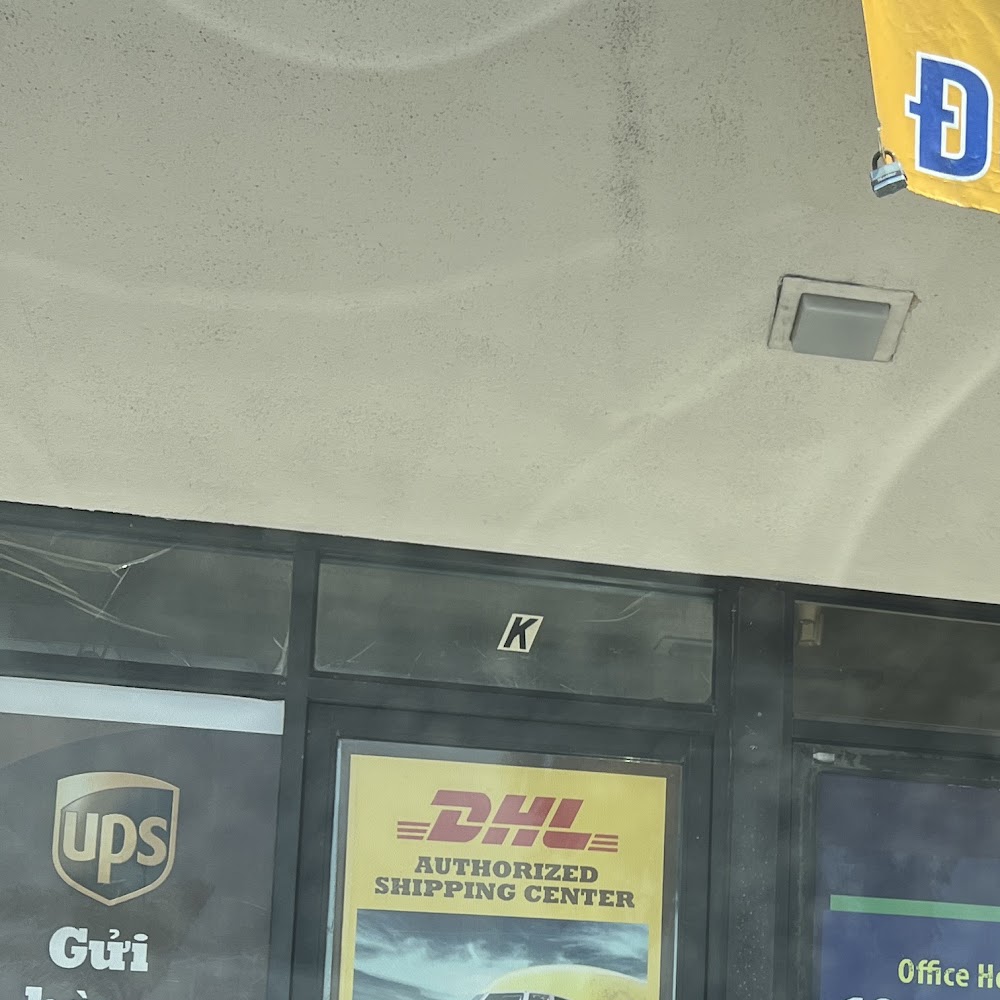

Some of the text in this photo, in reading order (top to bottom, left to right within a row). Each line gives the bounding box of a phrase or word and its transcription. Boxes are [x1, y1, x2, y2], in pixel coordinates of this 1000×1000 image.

[503, 616, 539, 650] K
[427, 789, 592, 851] DHL
[414, 856, 598, 883] AUTHORIZED
[374, 876, 635, 908] SHIPPING CENTER
[49, 926, 148, 972] Gửi
[898, 958, 969, 987] Office
